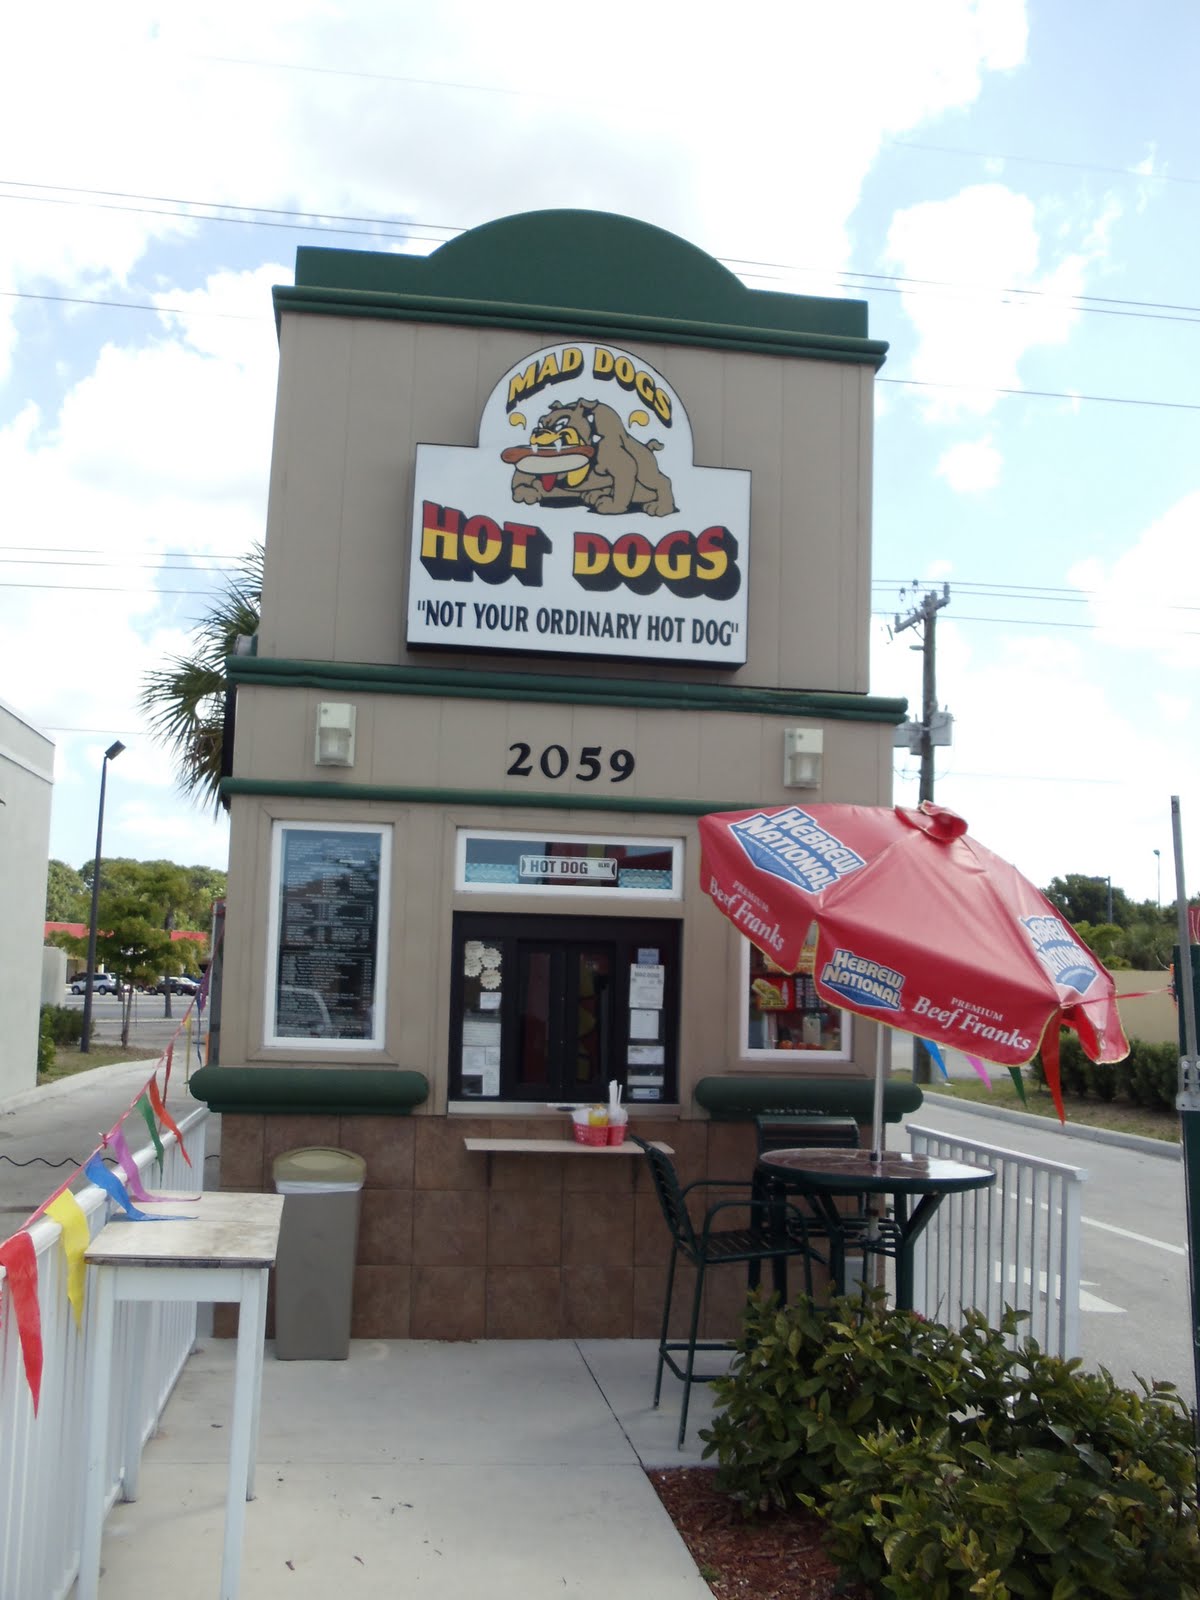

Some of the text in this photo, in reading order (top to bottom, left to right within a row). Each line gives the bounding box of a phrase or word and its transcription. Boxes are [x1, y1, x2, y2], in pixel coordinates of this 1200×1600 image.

[506, 347, 673, 428] MAD DOGS
[420, 500, 741, 600] HOT DOGS
[416, 599, 739, 647] "NOT YOUR ORDINARY HOT DOG"
[506, 742, 636, 783] 2059
[530, 859, 557, 874] HOT
[560, 861, 588, 875] DOG
[735, 816, 835, 891] NATIONAL
[770, 809, 861, 874] HEBREW
[709, 875, 785, 952] Beef Franks
[823, 963, 900, 1009] NATIONAL
[833, 950, 904, 990] HEBREW
[911, 995, 959, 1029] Beef
[959, 1008, 1033, 1051] Franks
[951, 996, 1005, 1023] PREMIUM
